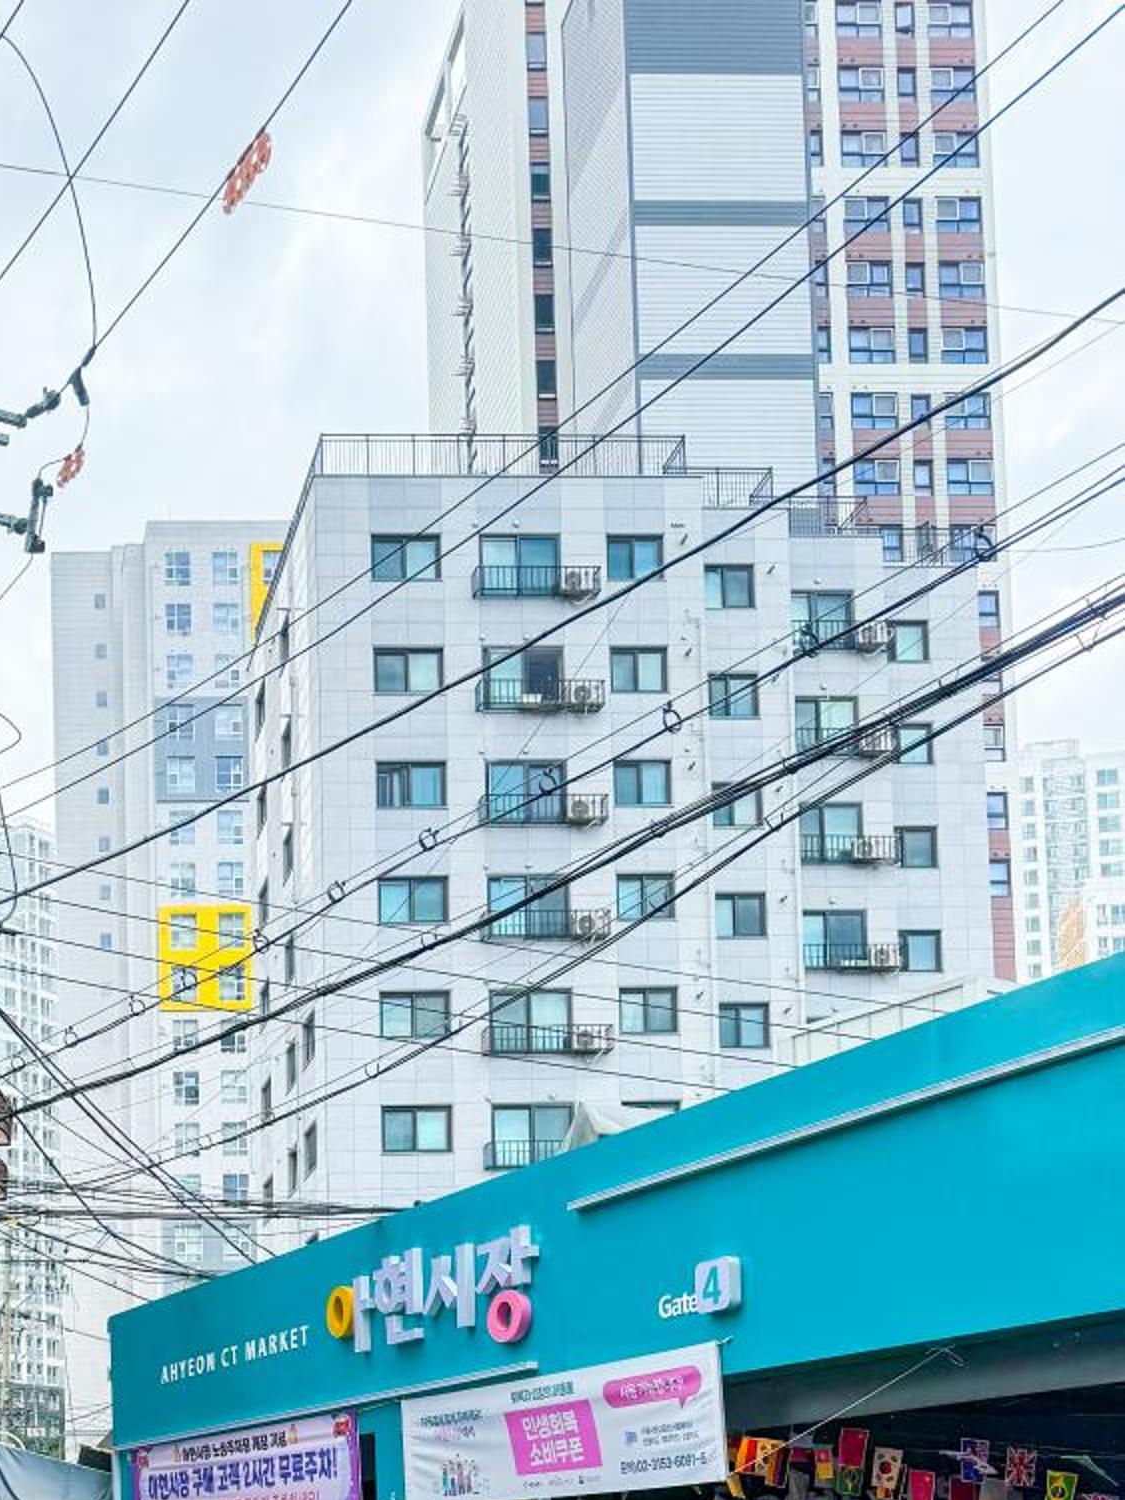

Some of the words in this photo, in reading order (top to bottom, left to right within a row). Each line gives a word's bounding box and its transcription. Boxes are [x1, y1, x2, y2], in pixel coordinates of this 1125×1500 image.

[326, 1224, 539, 1352] 아현시장
[658, 1291, 697, 1318] Gate
[702, 1265, 722, 1306] 4
[160, 1352, 216, 1385] AHYEON
[220, 1344, 239, 1367] CT
[244, 1325, 310, 1361] MARKET
[522, 1409, 579, 1441] 민생회복
[148, 1469, 189, 1500] 아현시장
[243, 1457, 276, 1488] 2시간
[279, 1448, 339, 1485] 무료주차!
[530, 1436, 585, 1467] 소비쿠폰
